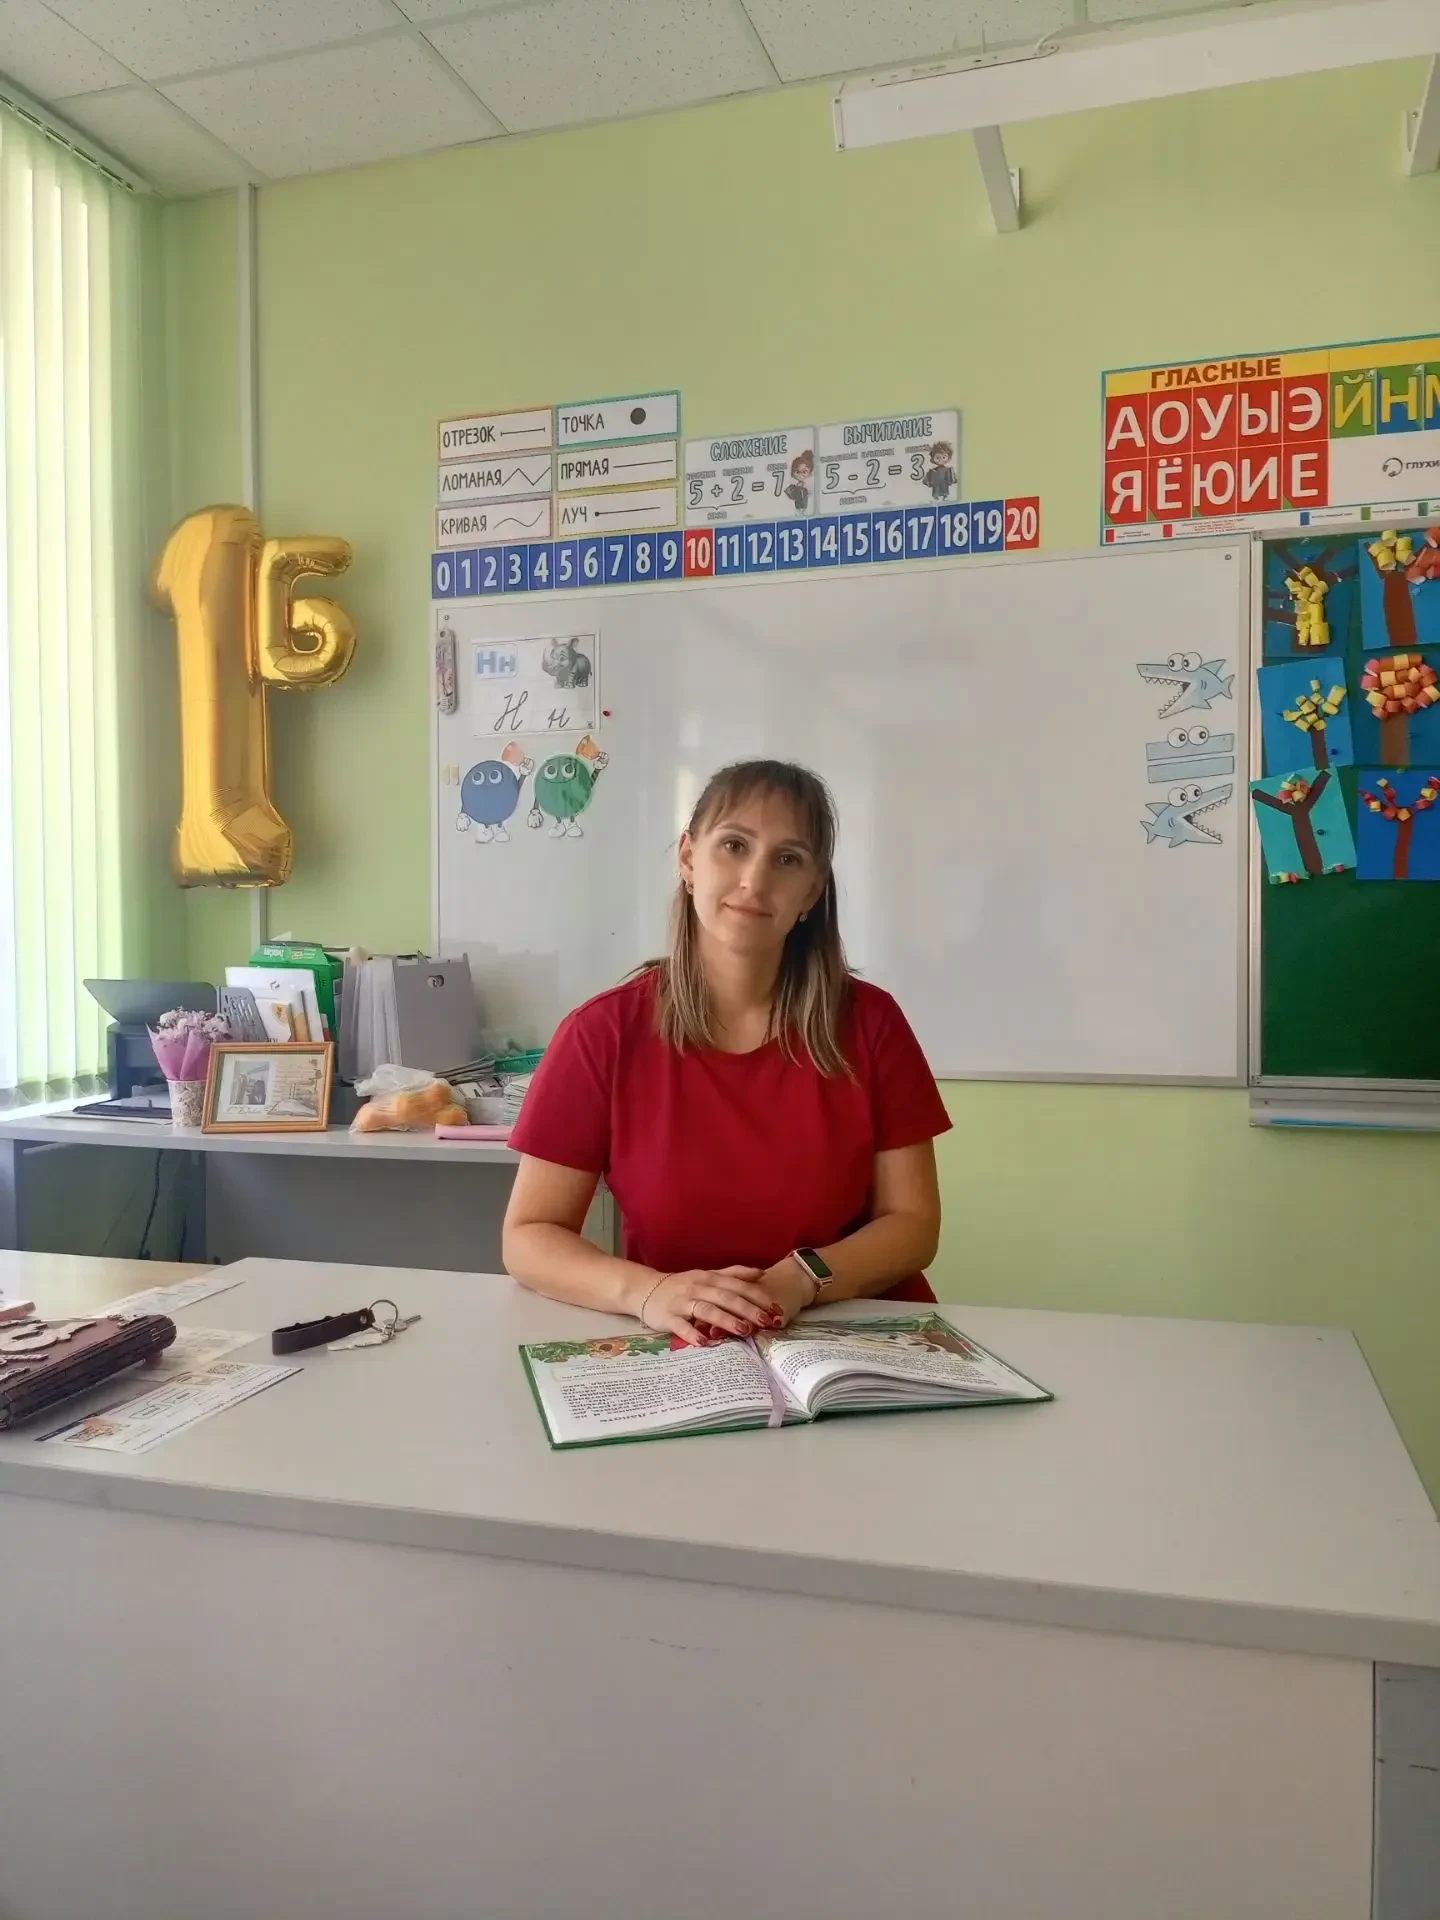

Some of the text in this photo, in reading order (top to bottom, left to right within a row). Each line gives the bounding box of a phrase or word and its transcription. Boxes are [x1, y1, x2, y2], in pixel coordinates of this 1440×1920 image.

[1151, 357, 1281, 389] ГЛАСНЫЕ
[561, 413, 605, 435] ТОЧКА
[1107, 406, 1146, 451] А
[1196, 394, 1234, 441] У
[1240, 390, 1279, 436] Ы
[1288, 386, 1323, 432] Э
[1334, 373, 1372, 429] Й
[1381, 376, 1418, 423] Н
[442, 425, 496, 448] ОТРЕЗОК
[843, 416, 933, 446] ВЫЧИТАНИЕ
[710, 434, 788, 462] СЛОЖЕНИЕ
[442, 469, 502, 491] ЛОМАНАЯ
[560, 458, 610, 480] ПРЯМАЯ
[825, 463, 840, 490] 5
[866, 458, 881, 486] 2
[910, 453, 925, 481] 3
[1110, 452, 1319, 514] Я Ё Ю И Е
[689, 479, 704, 505] 5
[730, 475, 745, 502] 2
[772, 470, 785, 497] 7
[440, 515, 488, 536] КРИВАЯ
[561, 506, 588, 525] ЛУЧ
[436, 506, 1037, 592] 0 1 2 3 4 5 6 7 8 9 10 11 12 13 14 15 16 17 18 19 20
[493, 690, 529, 732] Н
